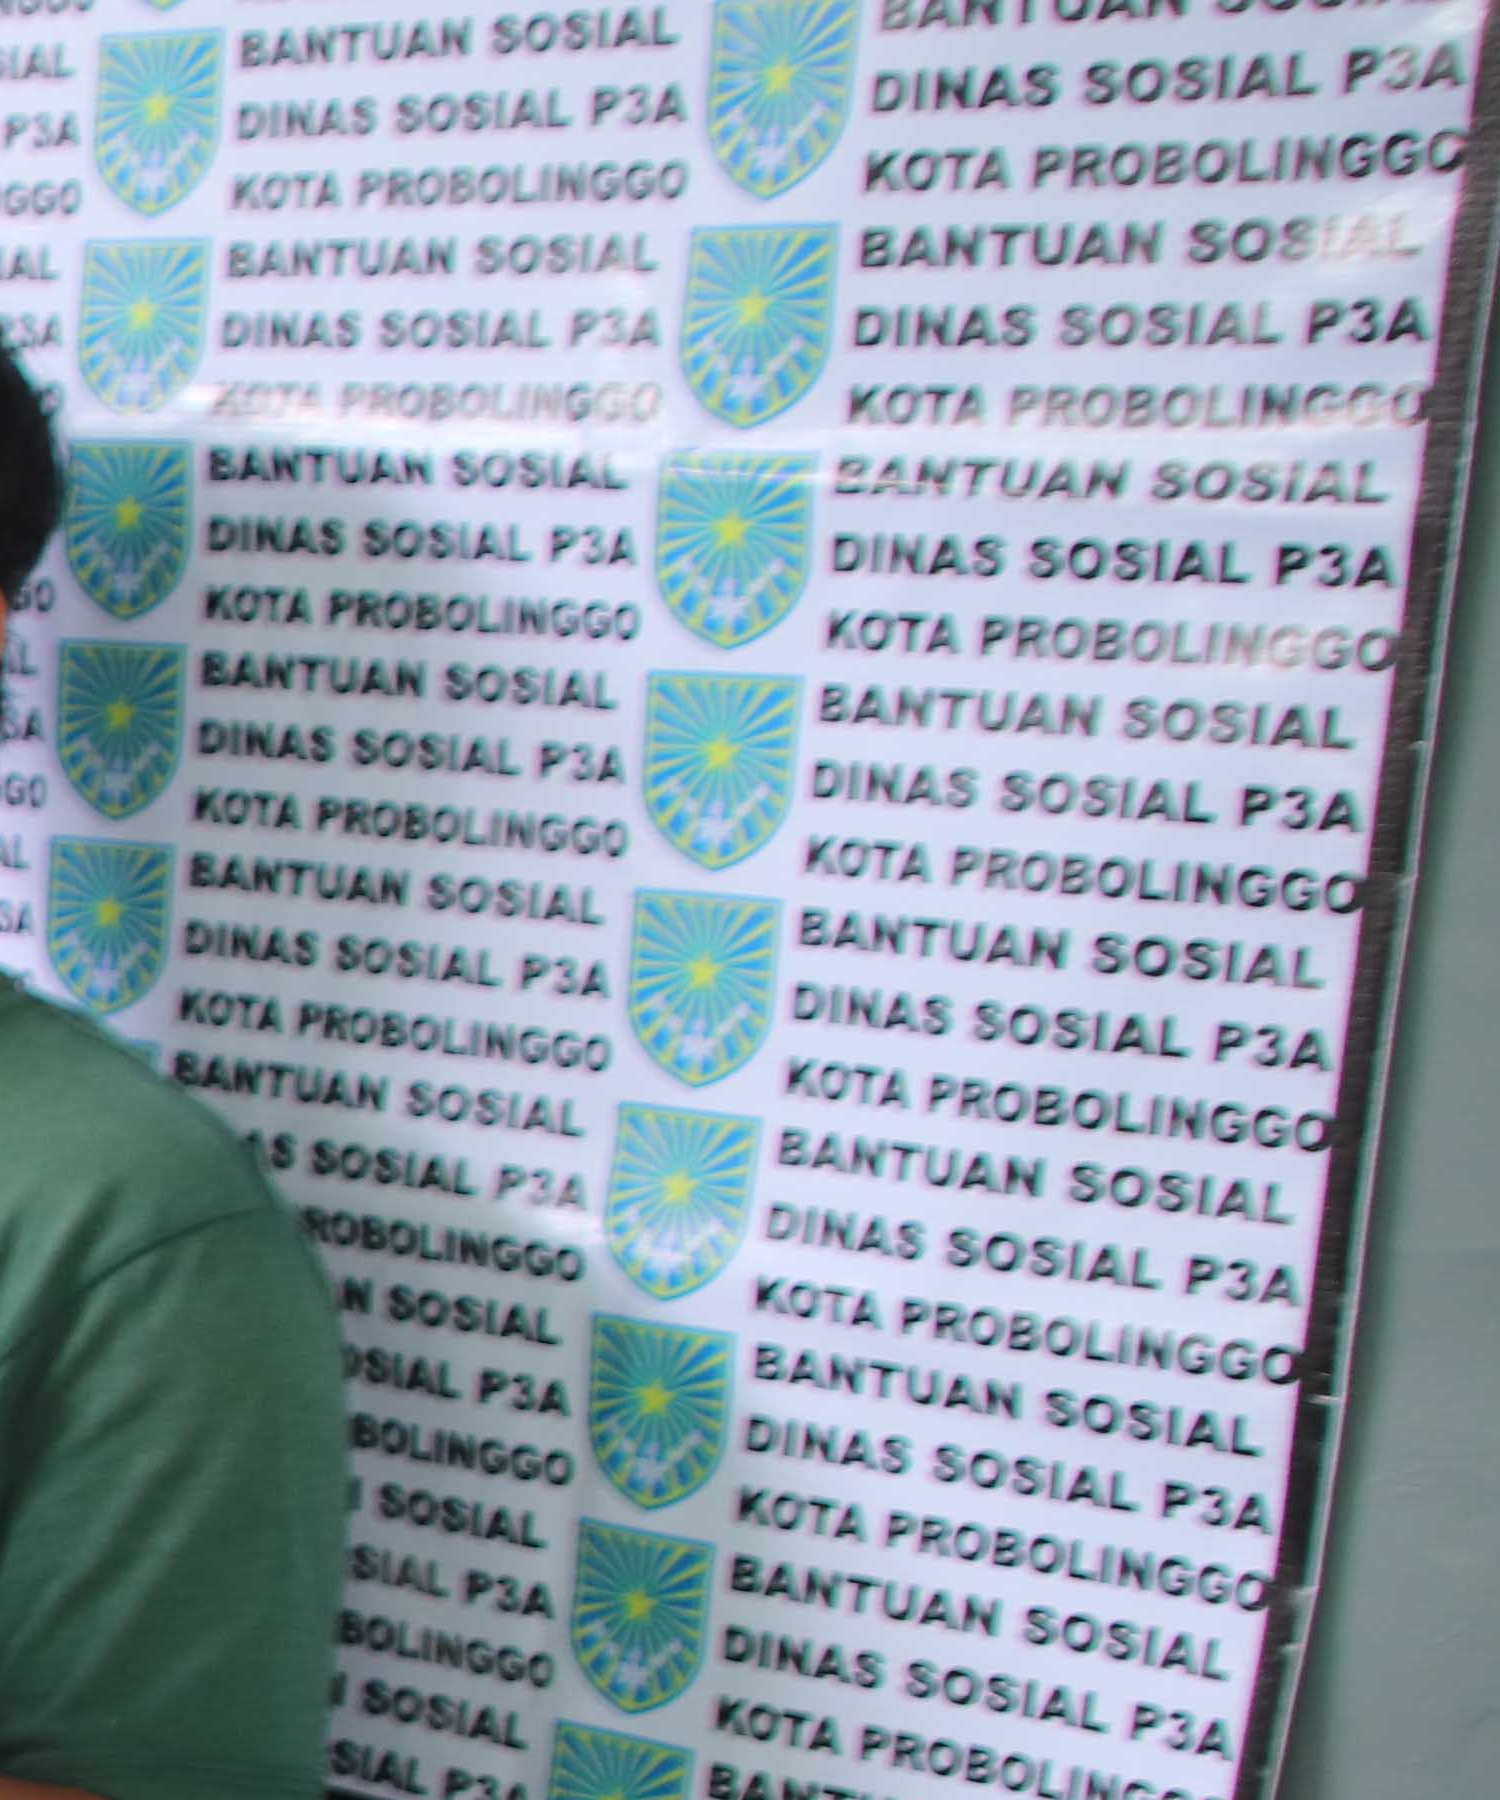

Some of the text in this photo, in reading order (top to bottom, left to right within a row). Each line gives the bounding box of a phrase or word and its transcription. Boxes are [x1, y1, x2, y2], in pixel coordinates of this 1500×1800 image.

[239, 6, 677, 71] BANTUAN SOSIAL
[236, 83, 686, 141] DINAS SOSIAL P3A
[872, 44, 1468, 115] DINAS SOSIAL P3A
[2, 112, 79, 152] P3A
[864, 128, 1470, 193] KOTA PROBOLINGGO
[231, 161, 688, 213] KOTA PROBOLINGGO
[226, 233, 656, 280] BANTUAN SOSIAL
[859, 215, 1420, 271] BANTUAN SOSIAL
[220, 308, 660, 351] DINAS SOSIAL P3A
[853, 299, 1433, 350] DINAS SOSIAL P3A
[847, 382, 1430, 430] KOTA PROBOLINGGO
[206, 447, 629, 493] BANTUAN SOSIAL
[833, 457, 1388, 505] BANTUAN SOSIAL
[206, 516, 635, 569] DINAS SOSIAL P3A
[832, 533, 1393, 589] DINAS SOSIAL P3A
[203, 586, 636, 643] KOTA PROBOLINGGO
[826, 611, 1397, 674] KOTA PROBOLINGGO
[200, 650, 615, 711] BANTUAN SOSIAL
[197, 719, 624, 786] DINAS SOSIAL P3A
[818, 684, 1354, 752] BANTUAN SOSIAL
[192, 787, 624, 859] KOTA PROBOLINGGO
[811, 759, 1360, 834] DINAS SOSIAL P3A
[188, 852, 602, 928] BANTUAN SOSIAL
[804, 836, 1368, 916] KOTA PROBOLINGGO
[182, 919, 608, 1002] DINAS SOSIAL P3A
[799, 909, 1320, 991] BANTUAN SOSIAL
[178, 988, 607, 1073] KOTA PROBOLINGGO
[792, 982, 1334, 1072] DINAS SOSIAL P3A
[172, 1050, 583, 1139] BANTUAN SOSIAL
[785, 1058, 1338, 1154] KOTA PROBOLINGGO
[310, 1137, 473, 1199] SOSIAL
[495, 1162, 584, 1212] P3A
[778, 1129, 1289, 1226] BANTUAN SOSIAL
[305, 1208, 582, 1282] ROBOLINGGO
[766, 1202, 1298, 1307] DINAS SOSIAL P3A
[388, 1283, 559, 1347] SOSIAL
[753, 1277, 1302, 1387] KOTA PROBOLINGGO
[476, 1368, 568, 1418] P3A
[753, 1343, 1260, 1459] BANTUAN SOSIAL
[351, 1416, 572, 1486] BOLINGGO
[744, 1413, 1276, 1537] DINAS SOSIAL P3A
[378, 1480, 544, 1551] SOSIAL
[733, 1484, 1277, 1612] KOTA PROBOLINGGO
[352, 1545, 553, 1621] SIAL P3A
[729, 1551, 1226, 1684] BANTUAN SOSIAL
[336, 1610, 552, 1688] BOLINGGO
[358, 1676, 526, 1752] SOSIAL
[714, 1694, 838, 1757] KOTA
[720, 1622, 1235, 1765] DINAS SOSIAL P3A
[331, 1739, 425, 1795] SIAL
